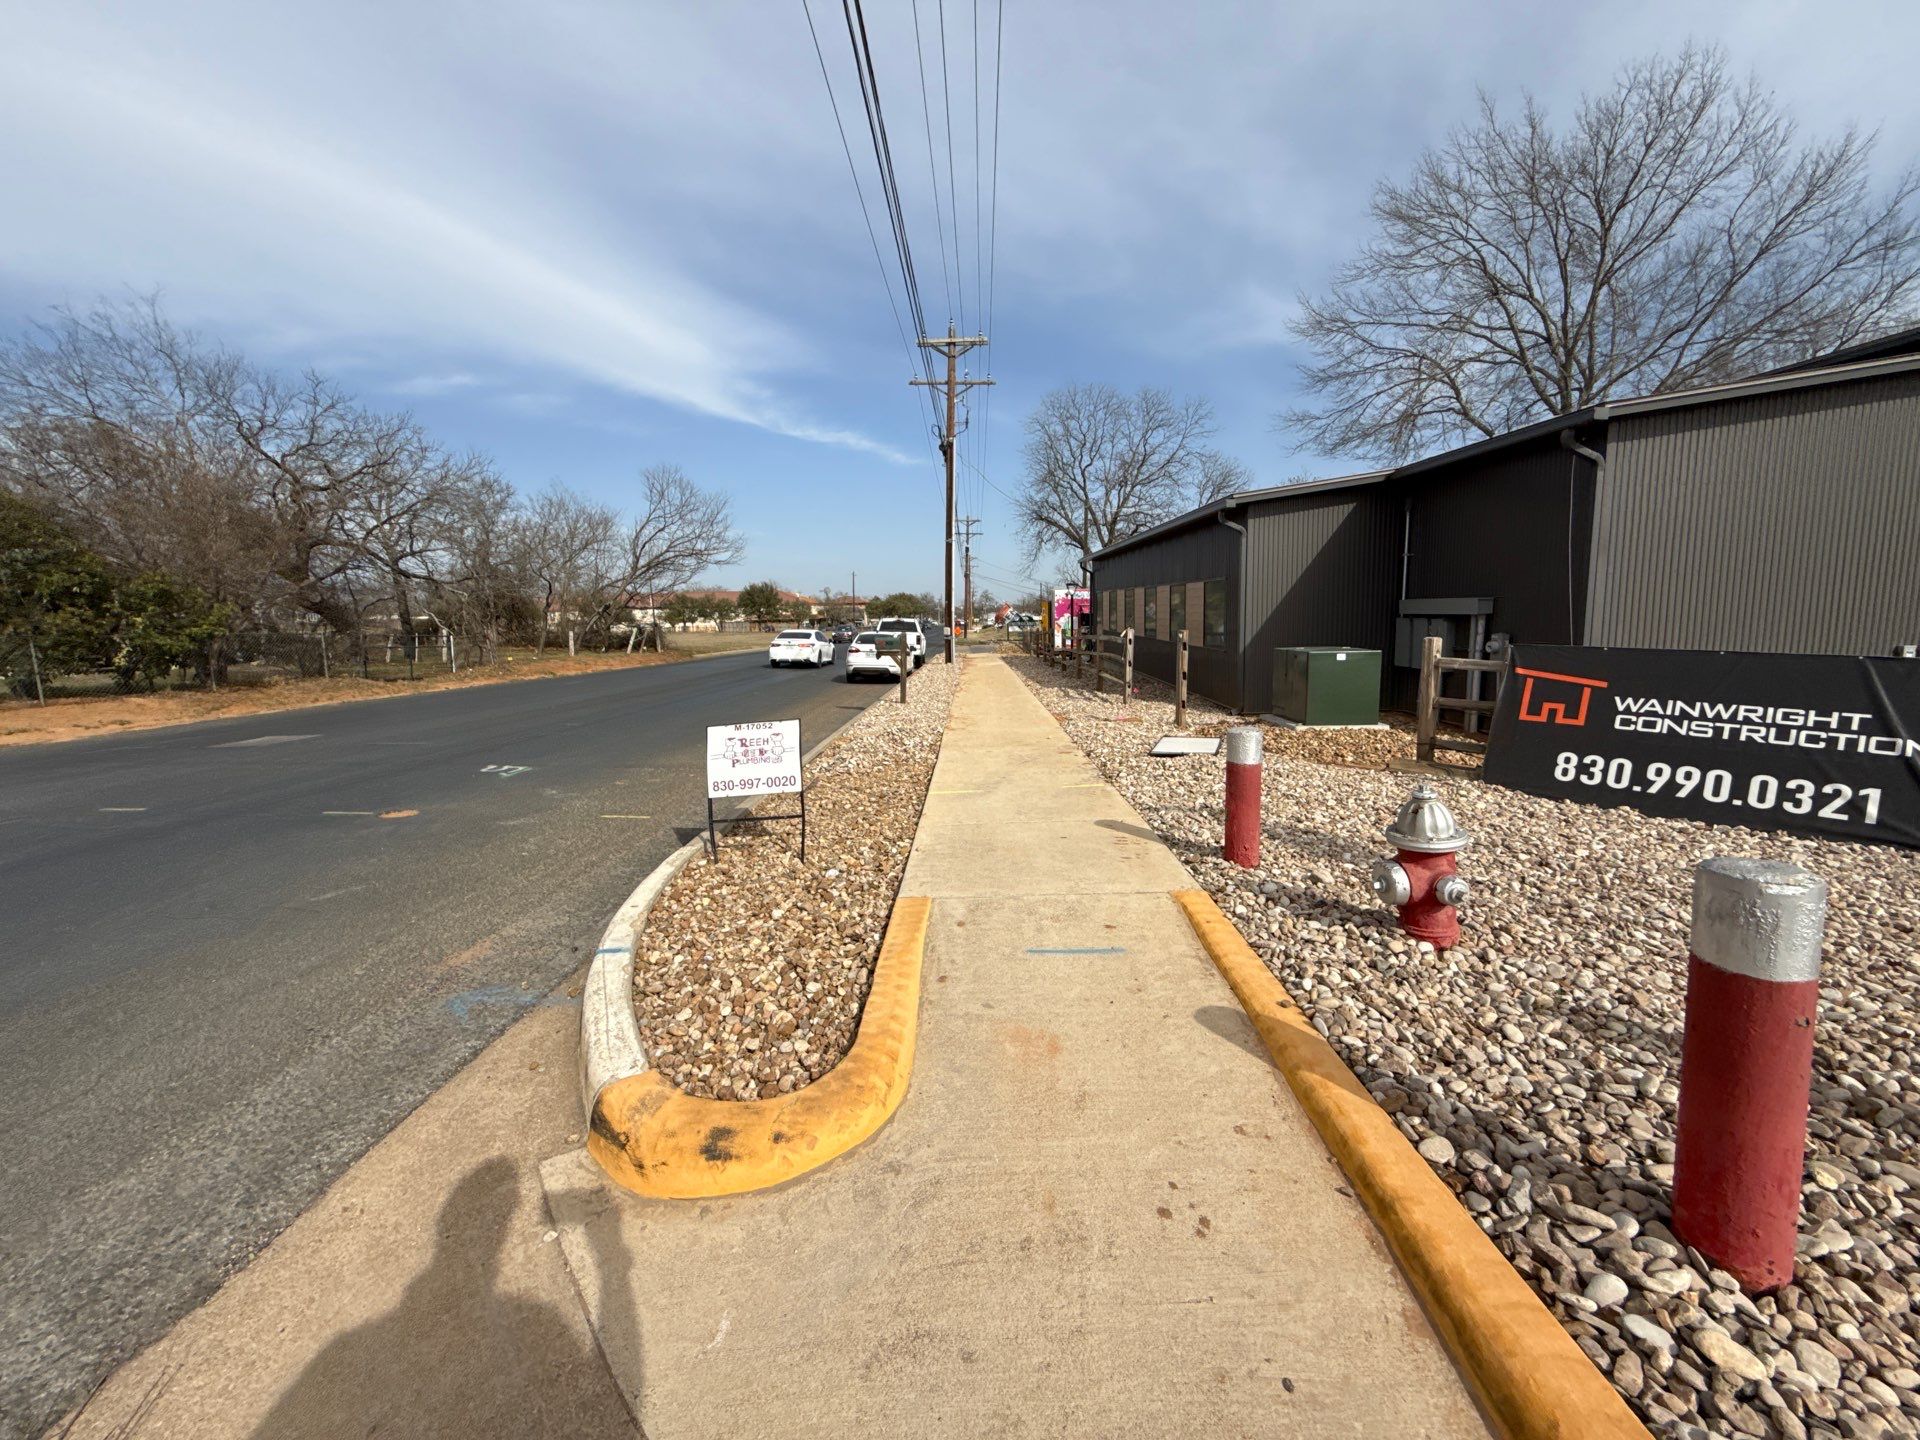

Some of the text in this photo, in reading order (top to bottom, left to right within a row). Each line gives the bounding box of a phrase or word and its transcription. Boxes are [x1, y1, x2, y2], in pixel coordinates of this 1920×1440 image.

[1613, 695, 1873, 731] WAINWRIGHT
[737, 738, 769, 747] REEH
[712, 775, 796, 792] 830-997-0020
[1553, 751, 1882, 825] 830.990.0321
